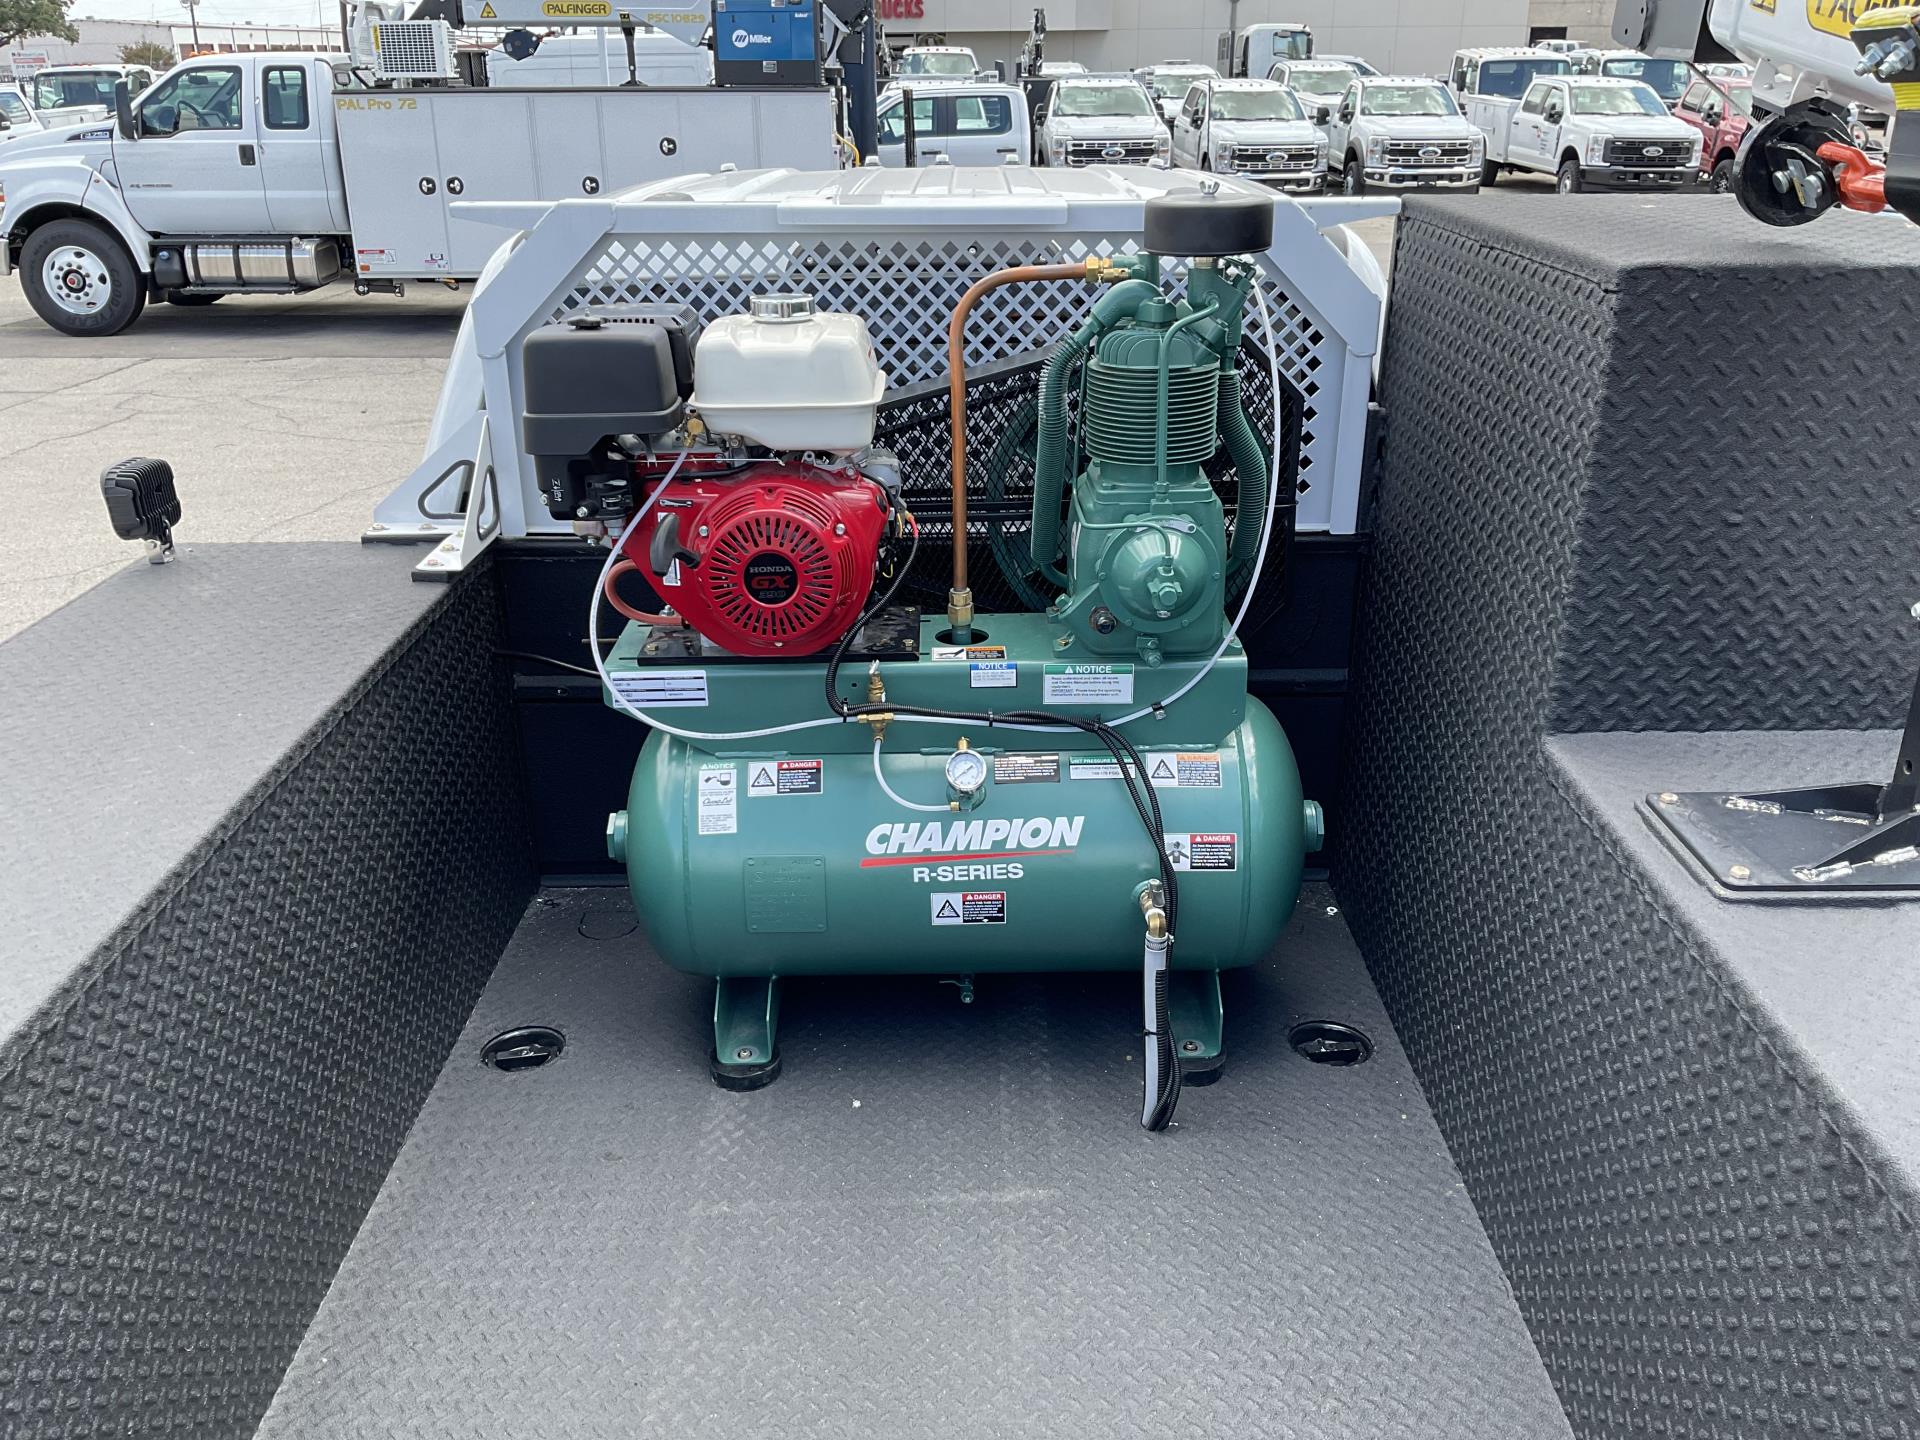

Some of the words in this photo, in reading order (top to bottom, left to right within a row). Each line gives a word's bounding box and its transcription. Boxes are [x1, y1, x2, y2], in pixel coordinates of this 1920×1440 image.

[547, 4, 607, 14] PALFINGER
[749, 34, 772, 43] Miller
[336, 98, 365, 110] PAL
[367, 98, 392, 110] Pro
[398, 98, 417, 110] 72
[752, 576, 790, 588] GX
[979, 662, 1008, 670] NOTICE
[1076, 665, 1112, 674] NOTICE
[865, 816, 1084, 854] CHAMPION
[914, 864, 1024, 883] R-SERIES
